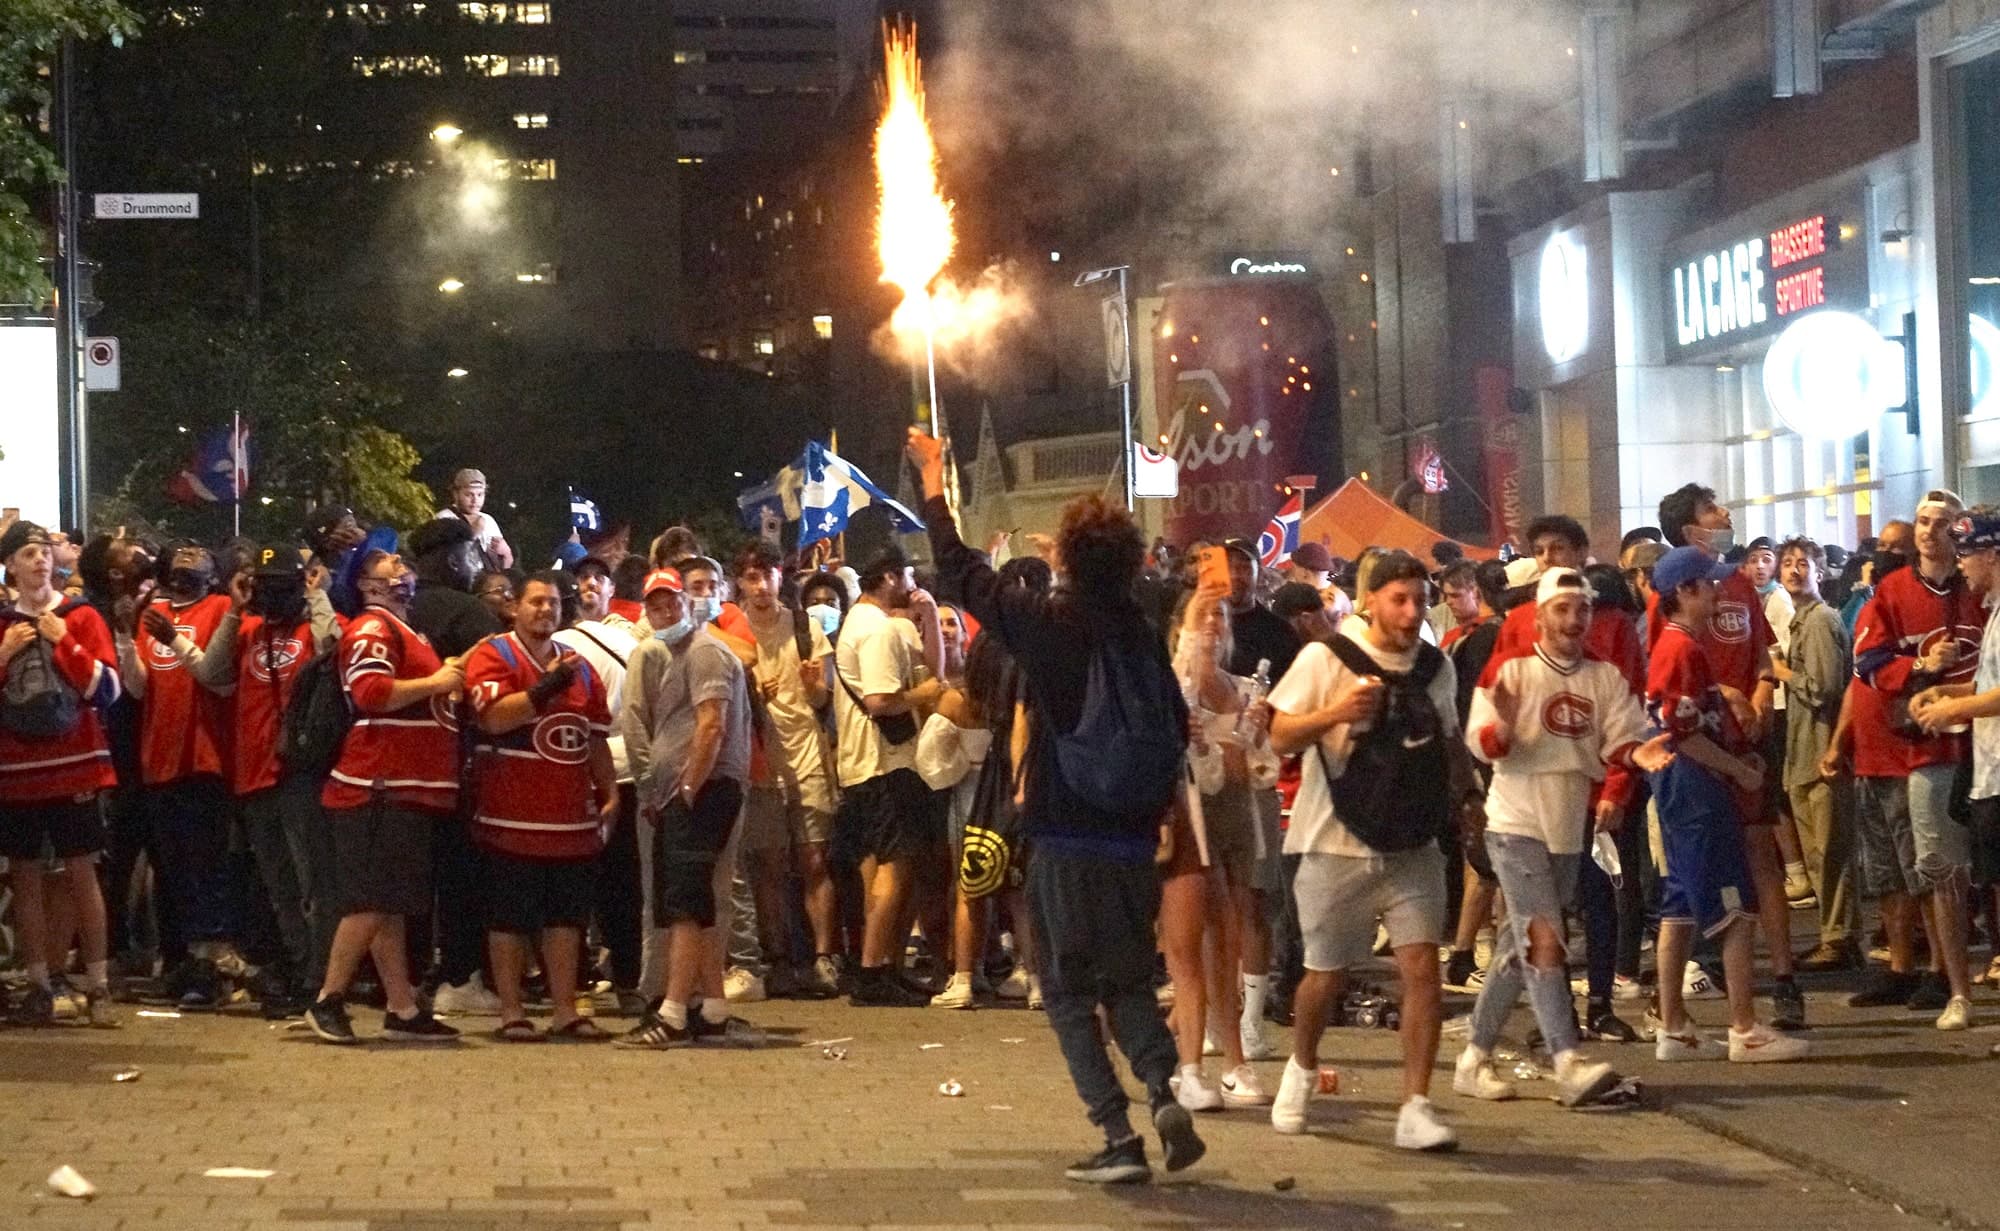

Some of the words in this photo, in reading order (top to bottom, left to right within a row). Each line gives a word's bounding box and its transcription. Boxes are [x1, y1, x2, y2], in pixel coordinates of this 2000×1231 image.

[123, 202, 192, 214] Drummond
[1770, 215, 1826, 268] BRASSERIE
[1674, 266, 1705, 346] LA
[1703, 238, 1767, 338] CAGE
[1775, 266, 1825, 316] SPORTIVE
[262, 549, 275, 566] P
